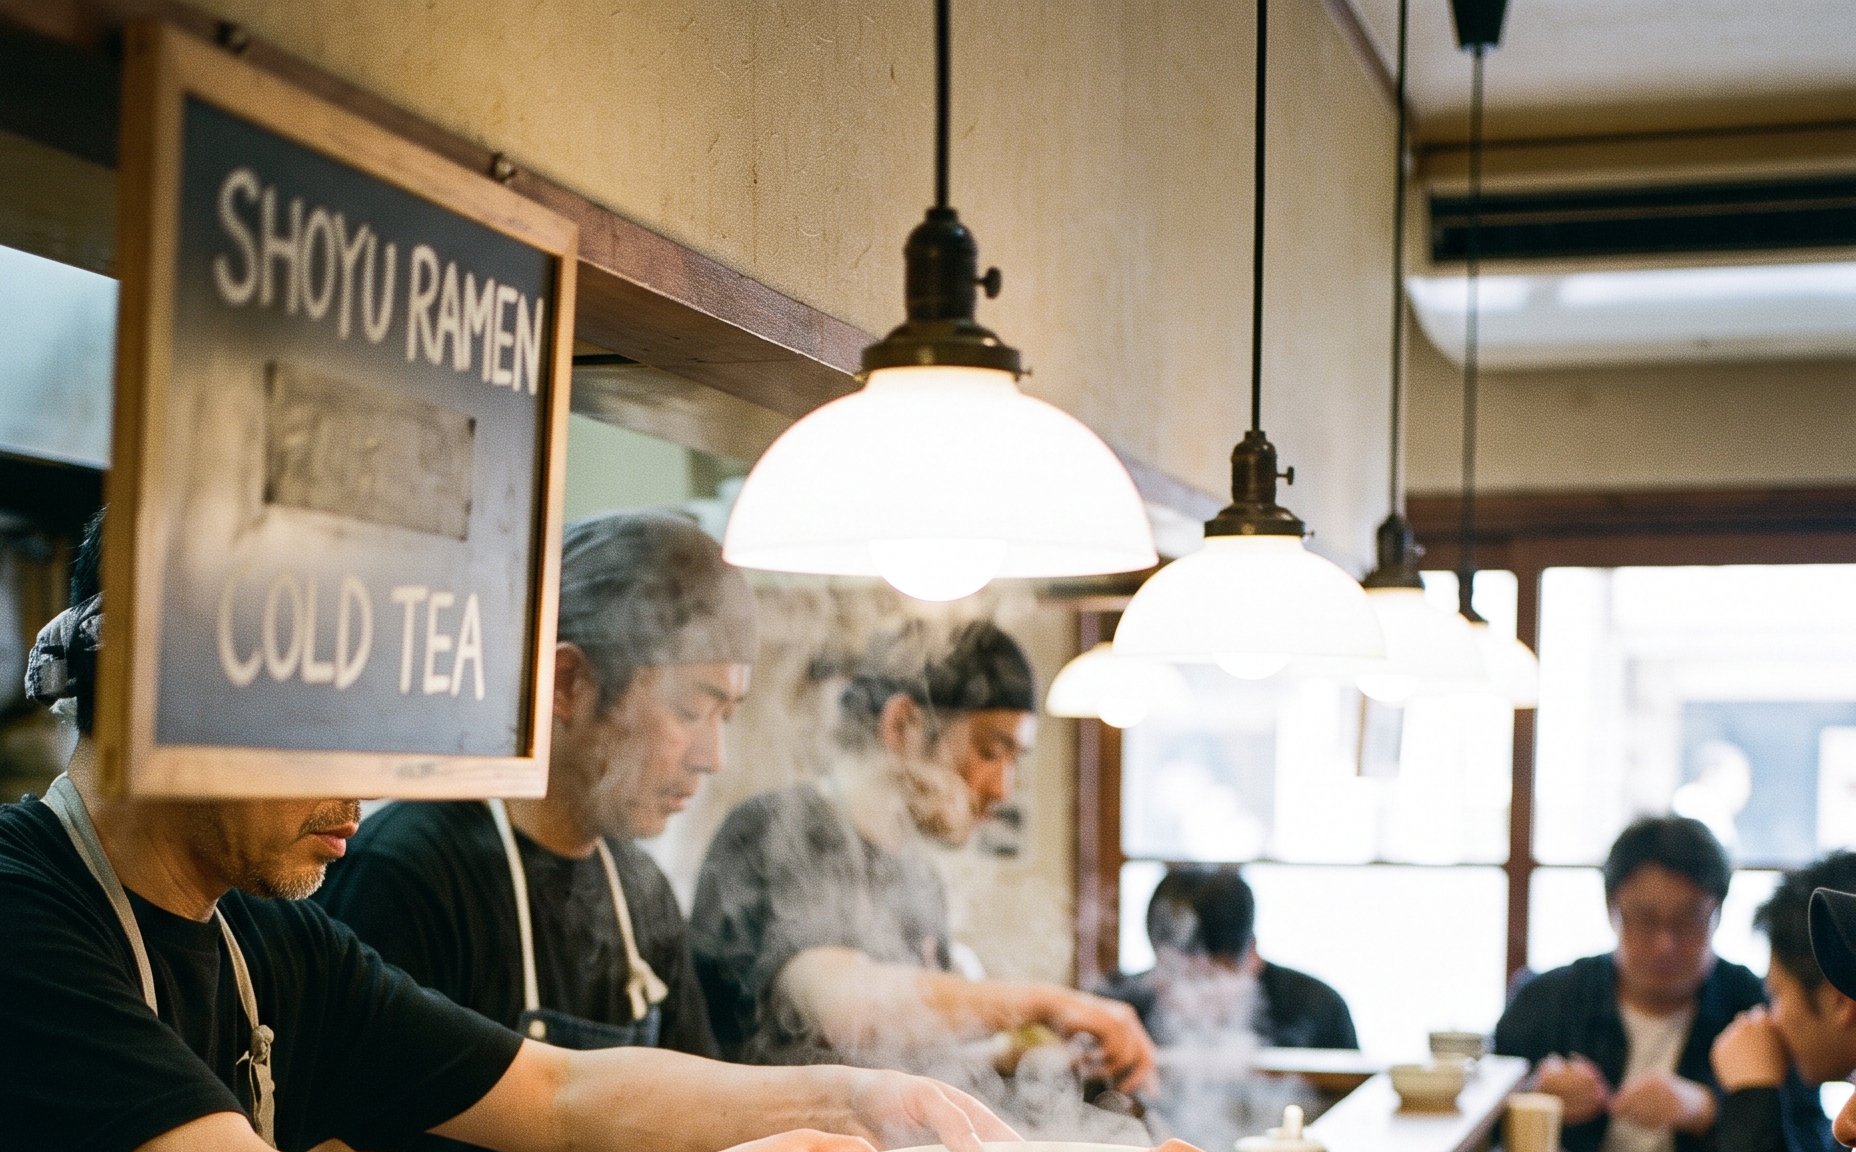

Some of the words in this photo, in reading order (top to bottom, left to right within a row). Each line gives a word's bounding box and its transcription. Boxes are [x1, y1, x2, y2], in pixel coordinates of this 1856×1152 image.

[215, 169, 396, 344] SHOYU
[408, 245, 544, 396] RAMEN
[217, 568, 373, 688] COLD
[393, 585, 485, 701] TEA
